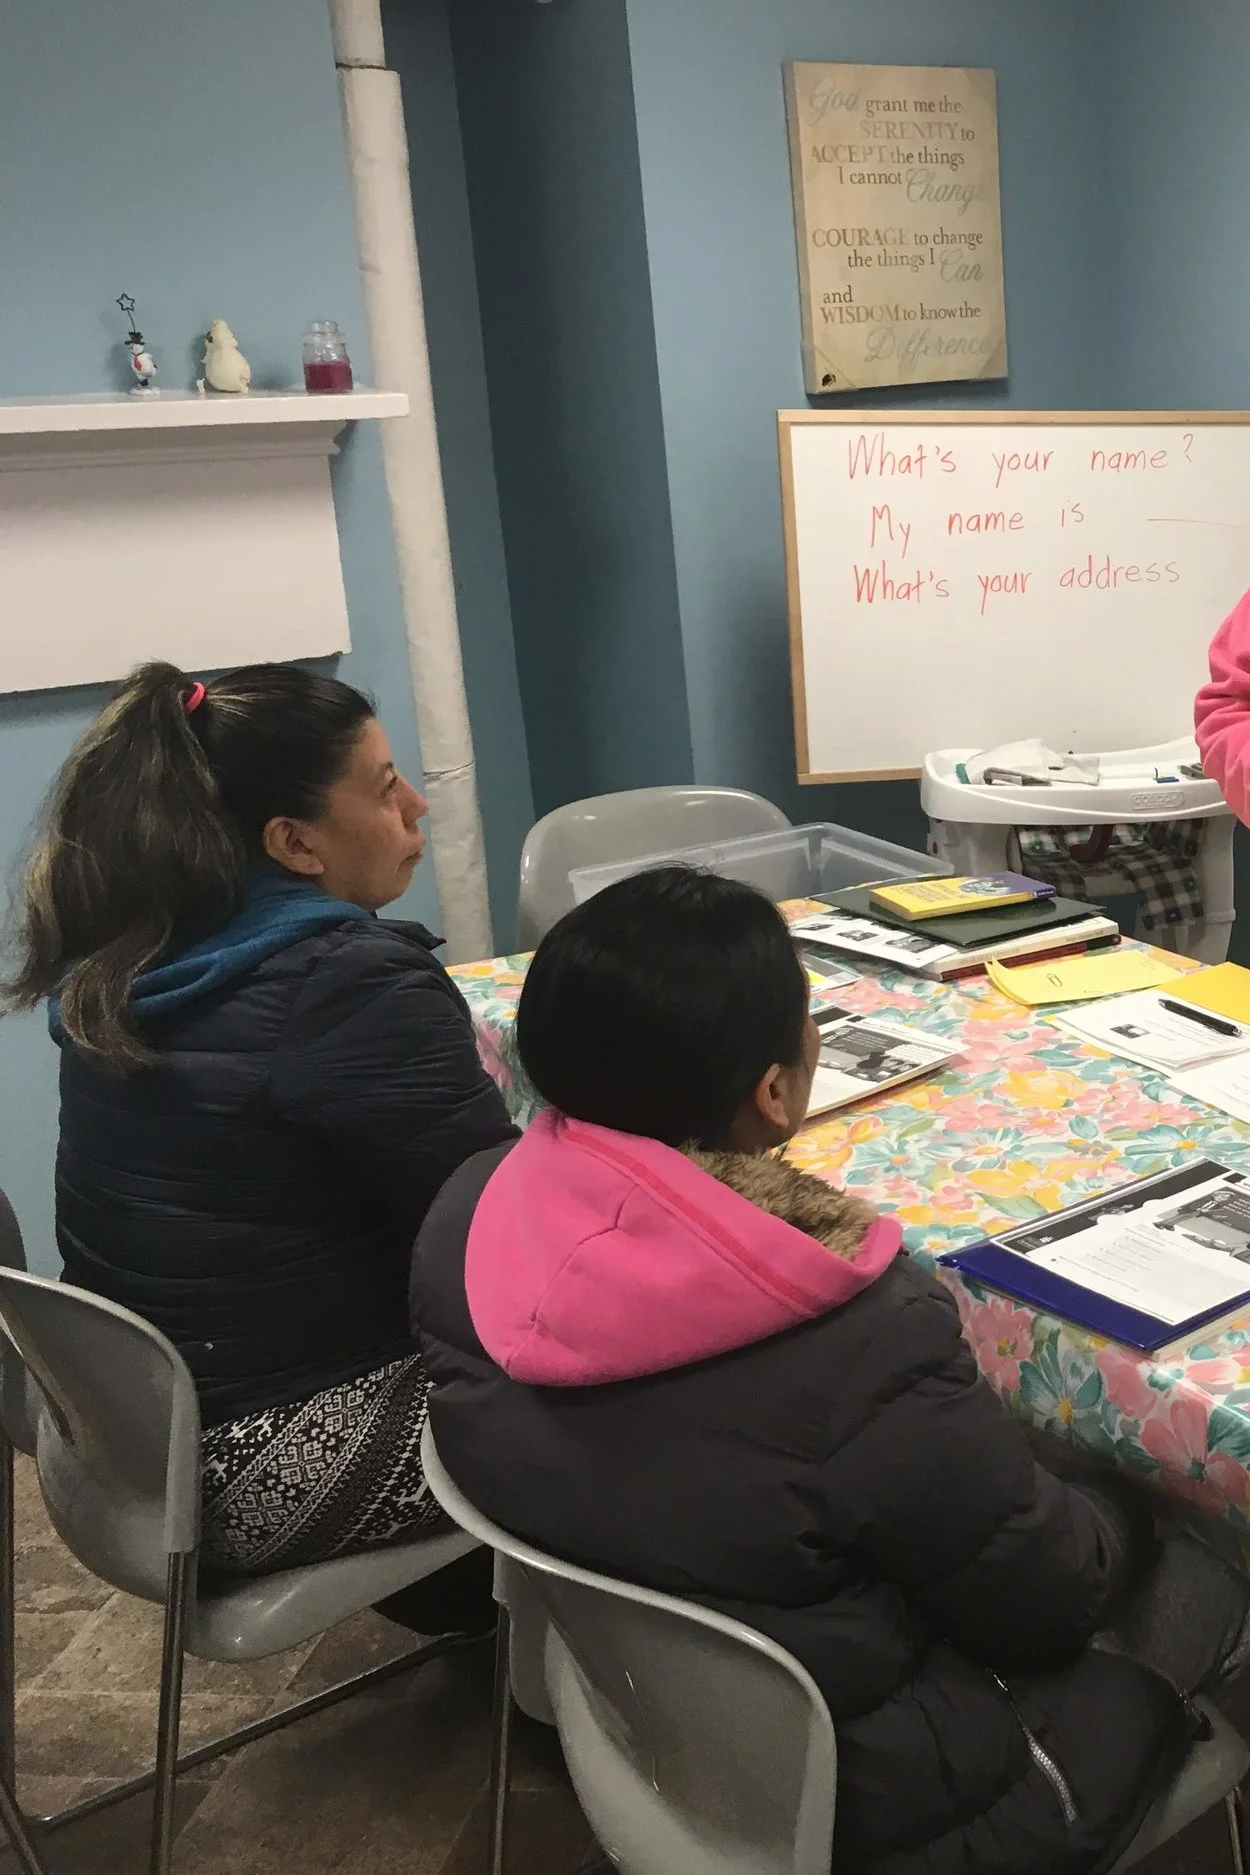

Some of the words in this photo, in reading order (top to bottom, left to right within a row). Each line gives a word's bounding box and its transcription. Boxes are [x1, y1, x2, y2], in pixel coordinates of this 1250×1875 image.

[865, 99, 907, 118] grant
[913, 100, 936, 112] me
[939, 95, 962, 113] the
[860, 120, 959, 140] SERENITY
[961, 128, 976, 141] to
[810, 144, 887, 164] ACCEPT
[889, 145, 914, 164] the
[918, 145, 965, 171] things
[838, 166, 844, 184] I
[850, 170, 902, 184] cannot
[812, 227, 909, 247] COURAGE
[914, 233, 929, 246] to
[933, 226, 983, 250] change
[848, 249, 873, 268] the
[877, 249, 925, 272] things
[929, 248, 935, 265] I
[939, 248, 984, 283] Can
[823, 285, 853, 304] and
[820, 303, 901, 325] WISDOM
[903, 309, 917, 321] to
[919, 302, 958, 320] know
[959, 301, 981, 318] the
[848, 432, 957, 480] What's
[992, 449, 1054, 489] your
[1090, 433, 1194, 474] name?
[870, 503, 911, 559] My
[948, 509, 1025, 536] name
[1060, 499, 1084, 528] is
[853, 559, 950, 604] What's
[977, 571, 1033, 616] your
[1058, 554, 1181, 590] address
